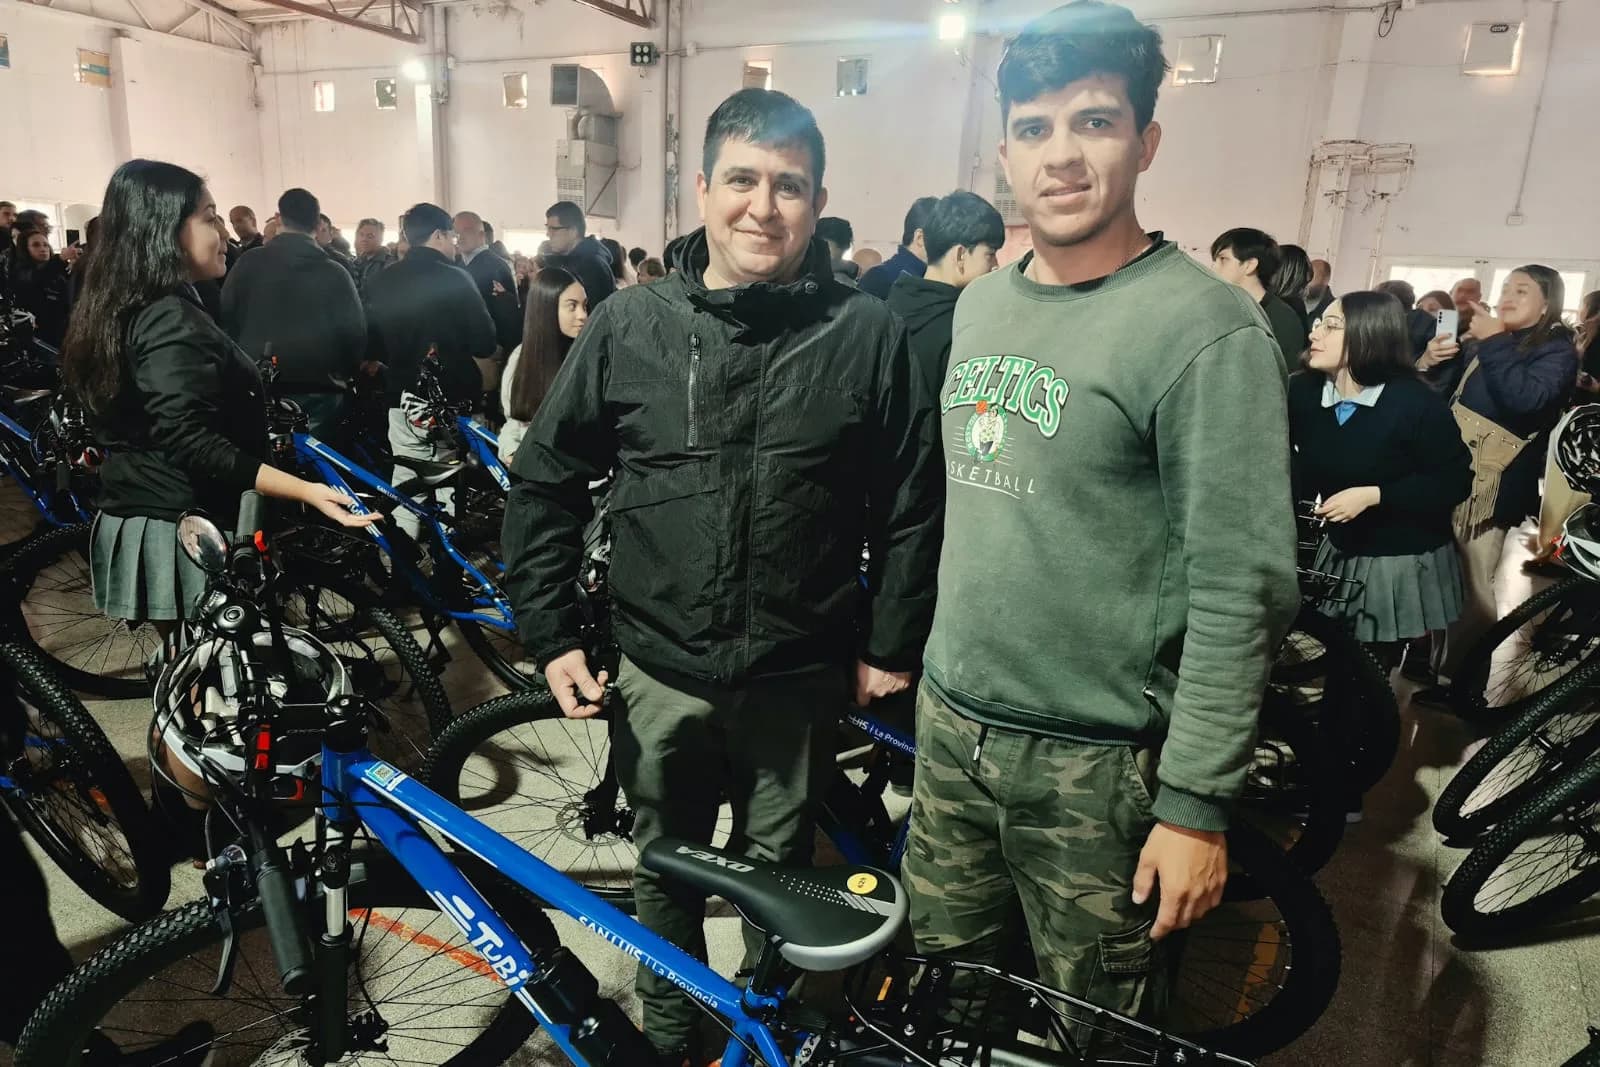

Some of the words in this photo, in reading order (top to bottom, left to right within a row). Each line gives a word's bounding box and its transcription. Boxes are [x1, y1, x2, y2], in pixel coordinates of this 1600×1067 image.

[941, 355, 1070, 439] CELTICS
[946, 459, 1036, 494] SKETBALL
[884, 733, 917, 755] Provinci
[578, 916, 611, 941] SAN
[651, 961, 665, 976] La
[667, 969, 719, 1009] Provincia
